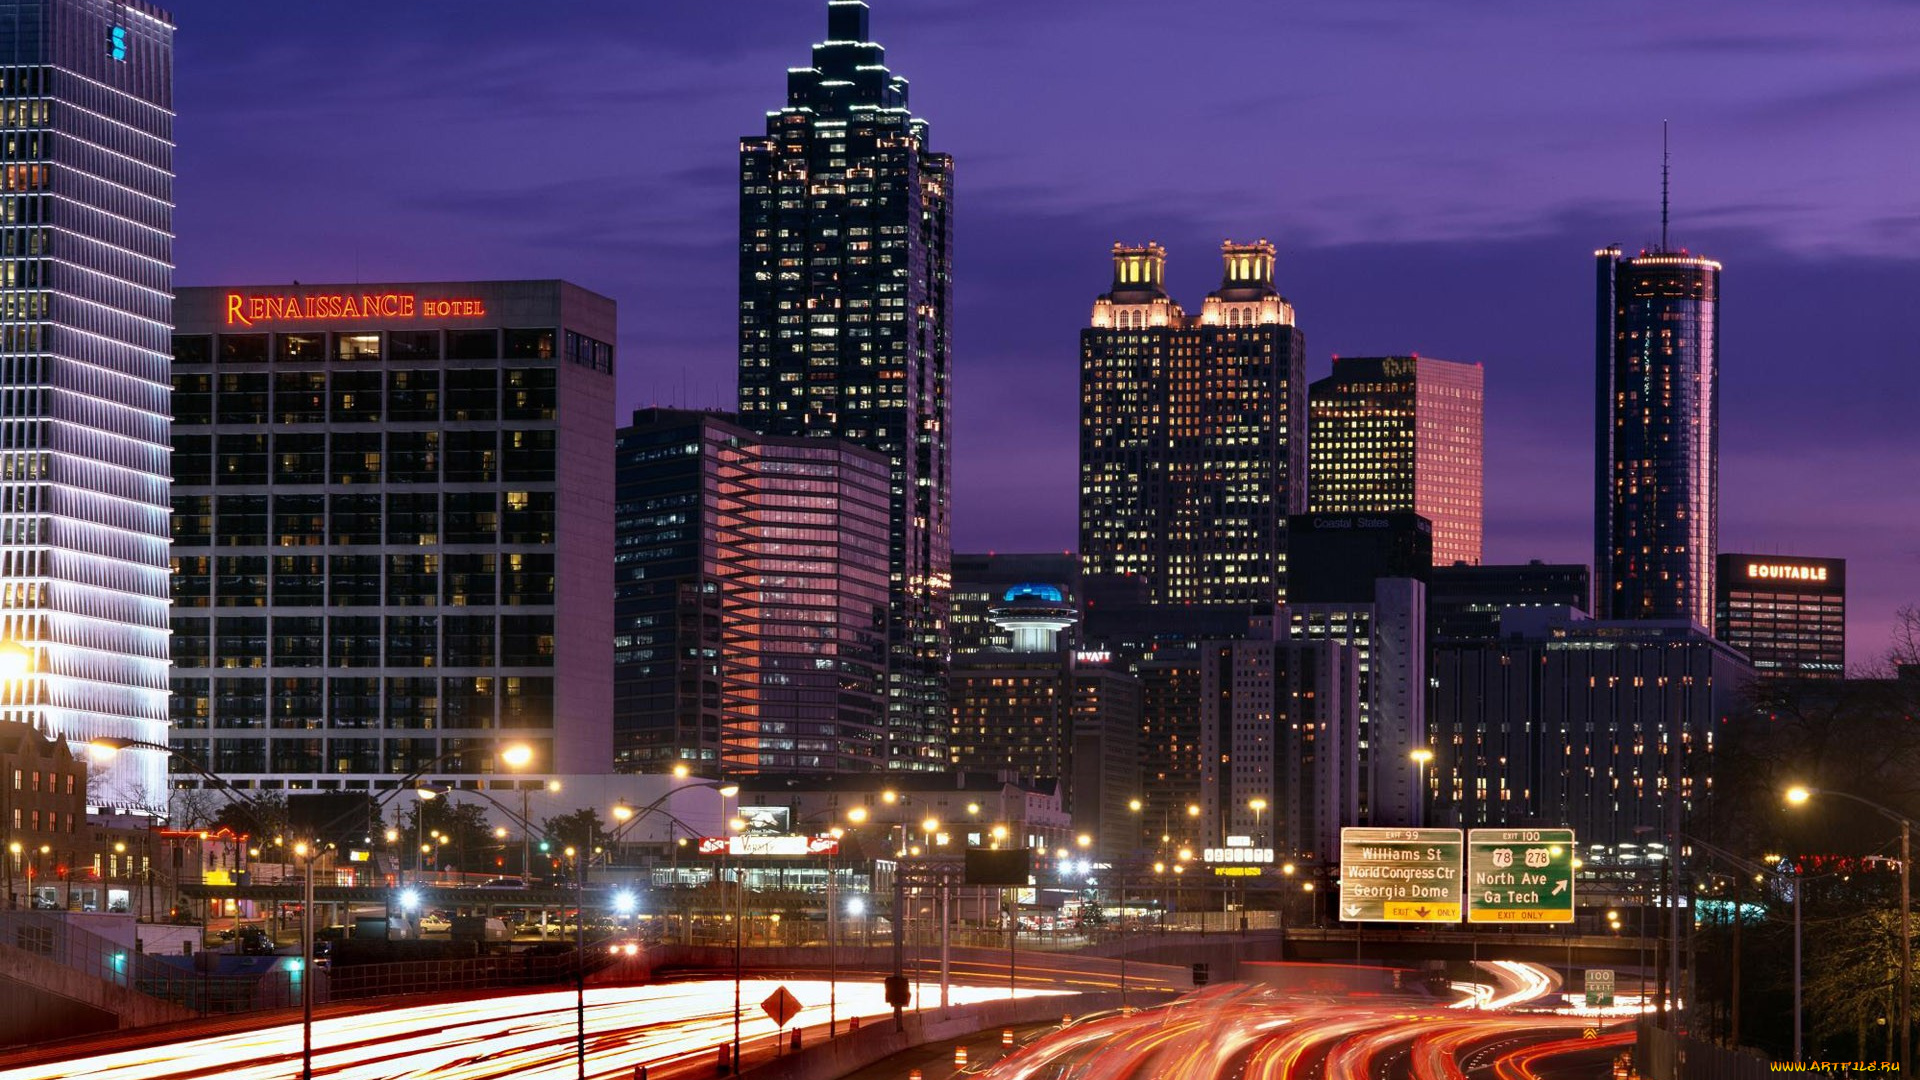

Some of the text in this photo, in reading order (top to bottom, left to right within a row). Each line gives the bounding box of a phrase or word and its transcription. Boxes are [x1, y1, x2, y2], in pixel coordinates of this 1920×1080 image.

[227, 294, 485, 325] RENAISSANCE HOTEL
[1313, 518, 1389, 528] Coastal States
[1748, 564, 1827, 580] EQUITABLE
[1077, 651, 1111, 661] HYATT
[1385, 831, 1418, 840] EXIT 99
[1503, 832, 1540, 841] EXIT 100
[1205, 849, 1273, 862] VARTY
[1362, 847, 1442, 860] Williams St
[1495, 852, 1511, 863] 78
[1527, 852, 1547, 863] 278
[1348, 866, 1455, 882] World Congress Ctr
[1476, 872, 1547, 885] North Ave
[1354, 884, 1449, 900] Georgia Dome
[1484, 891, 1539, 903] Ga Tech
[1393, 908, 1456, 916] EXIT ONLY
[1498, 911, 1544, 919] EXIT ONLY
[1590, 971, 1610, 980] 100
